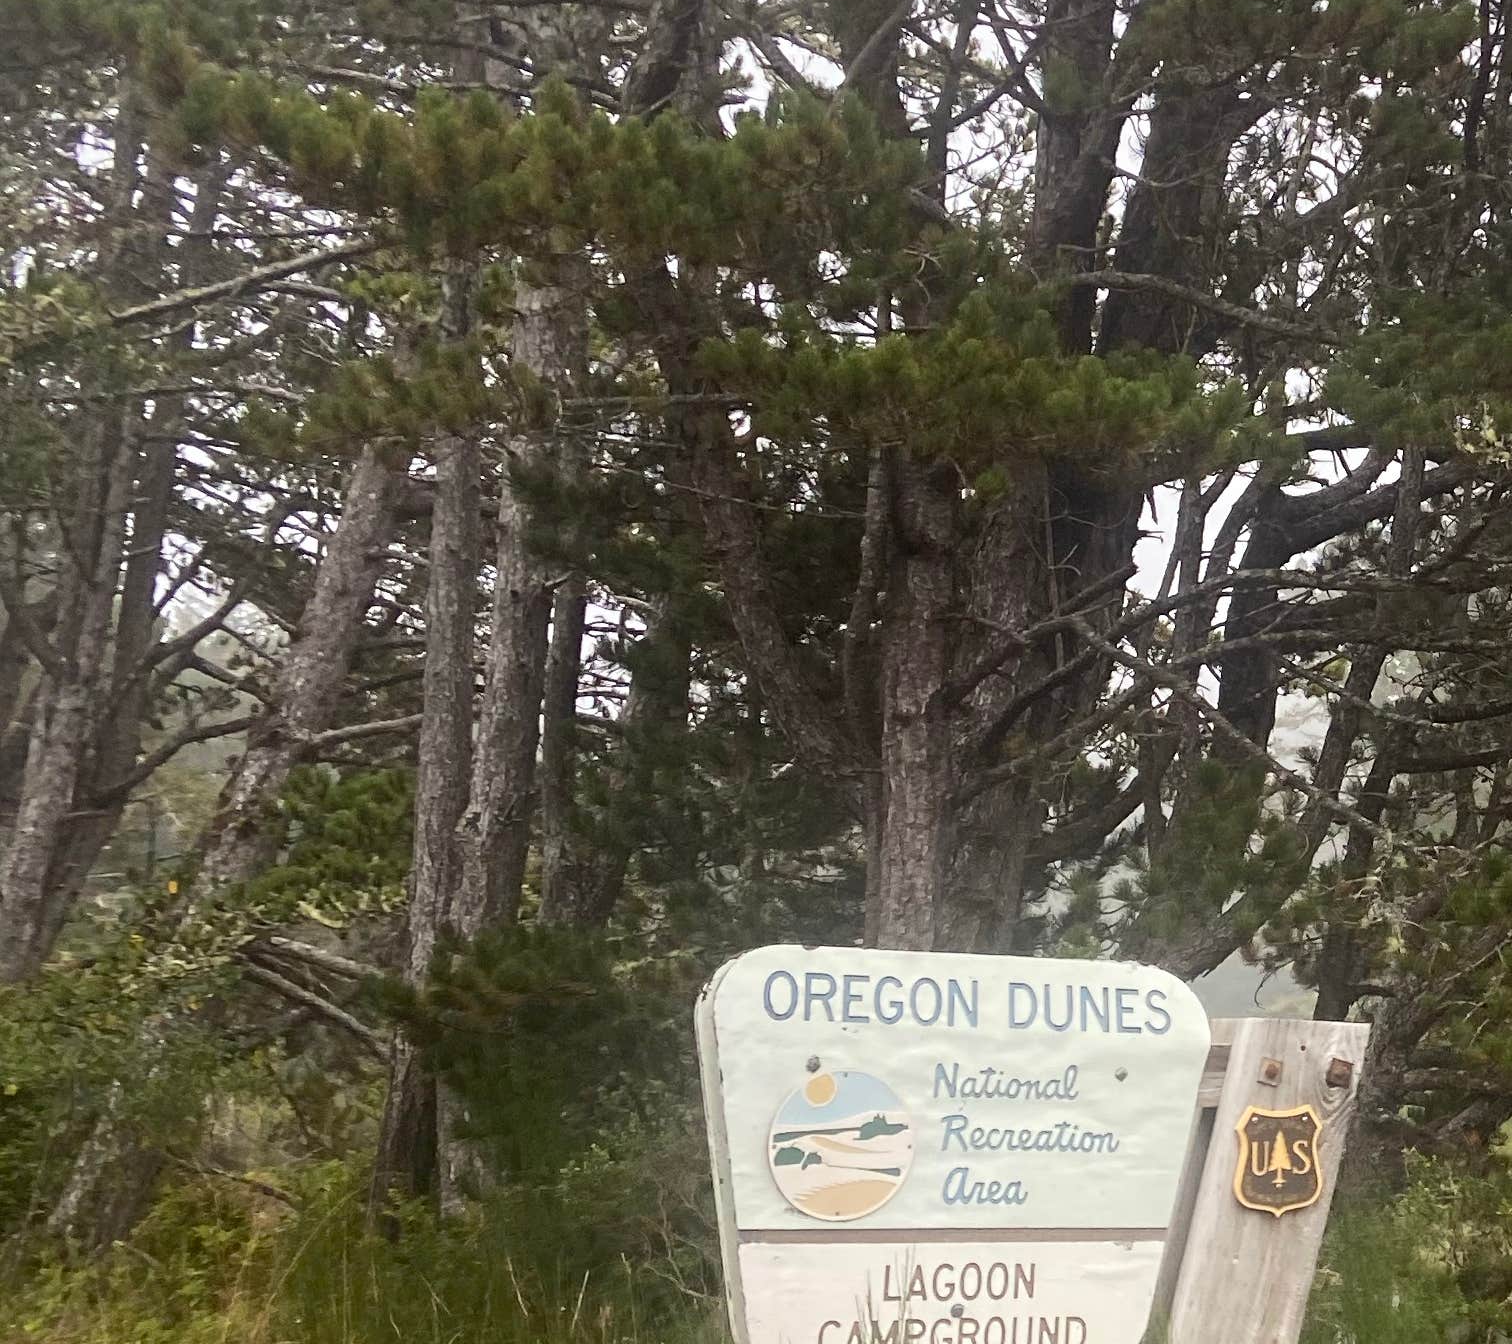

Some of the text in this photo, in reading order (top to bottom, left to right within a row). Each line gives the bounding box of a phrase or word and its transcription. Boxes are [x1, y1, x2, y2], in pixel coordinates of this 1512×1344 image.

[763, 970, 1172, 1035] OREGON DUNES
[932, 1062, 1080, 1100] National
[940, 1114, 1120, 1153] Recreation
[942, 1167, 1029, 1206] Area
[883, 1262, 1036, 1302] LAGOON
